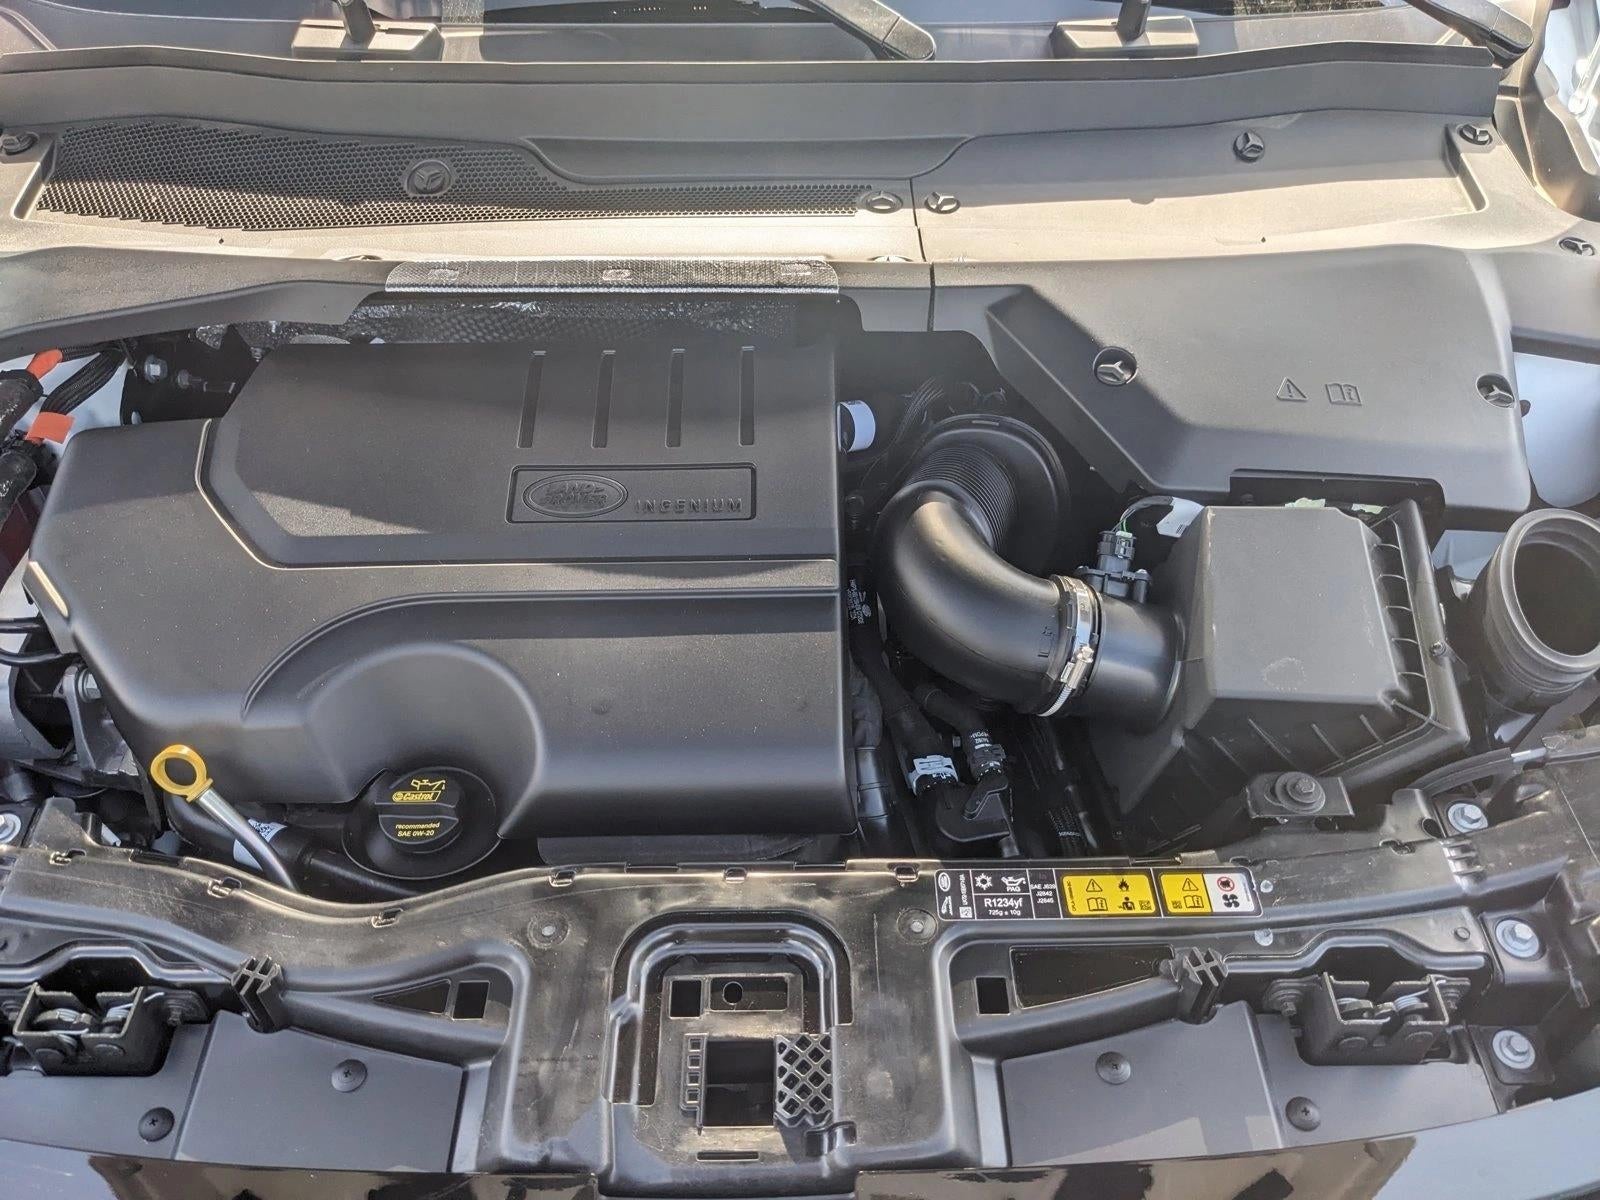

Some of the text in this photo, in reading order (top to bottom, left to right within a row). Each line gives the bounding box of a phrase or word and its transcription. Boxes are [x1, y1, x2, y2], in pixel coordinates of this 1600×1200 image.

[634, 497, 743, 514] INGENIUM
[403, 792, 434, 801] Castrol
[984, 897, 1023, 909] R1234yf
